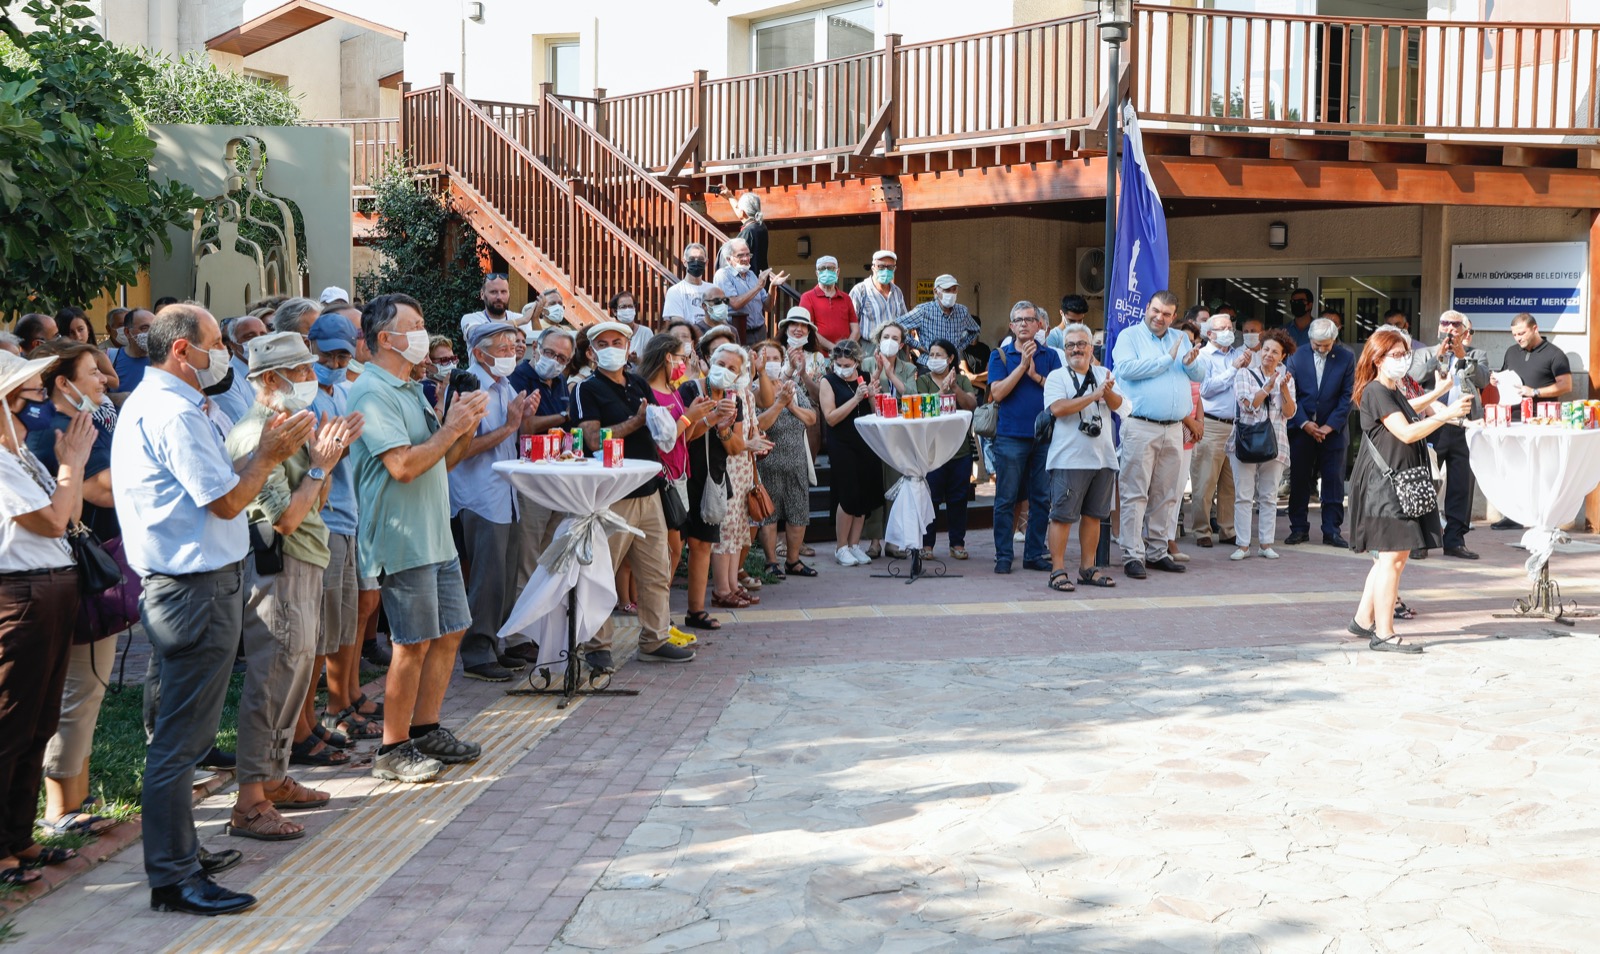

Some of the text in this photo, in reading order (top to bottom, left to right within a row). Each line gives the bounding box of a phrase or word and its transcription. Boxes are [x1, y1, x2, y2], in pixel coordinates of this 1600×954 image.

[1465, 270, 1581, 280] İZMİR BÜYÜKŞEHİR BELEDİYESİ
[1454, 296, 1580, 305] SEFERİHİSAR HİZMET MERKEZİ
